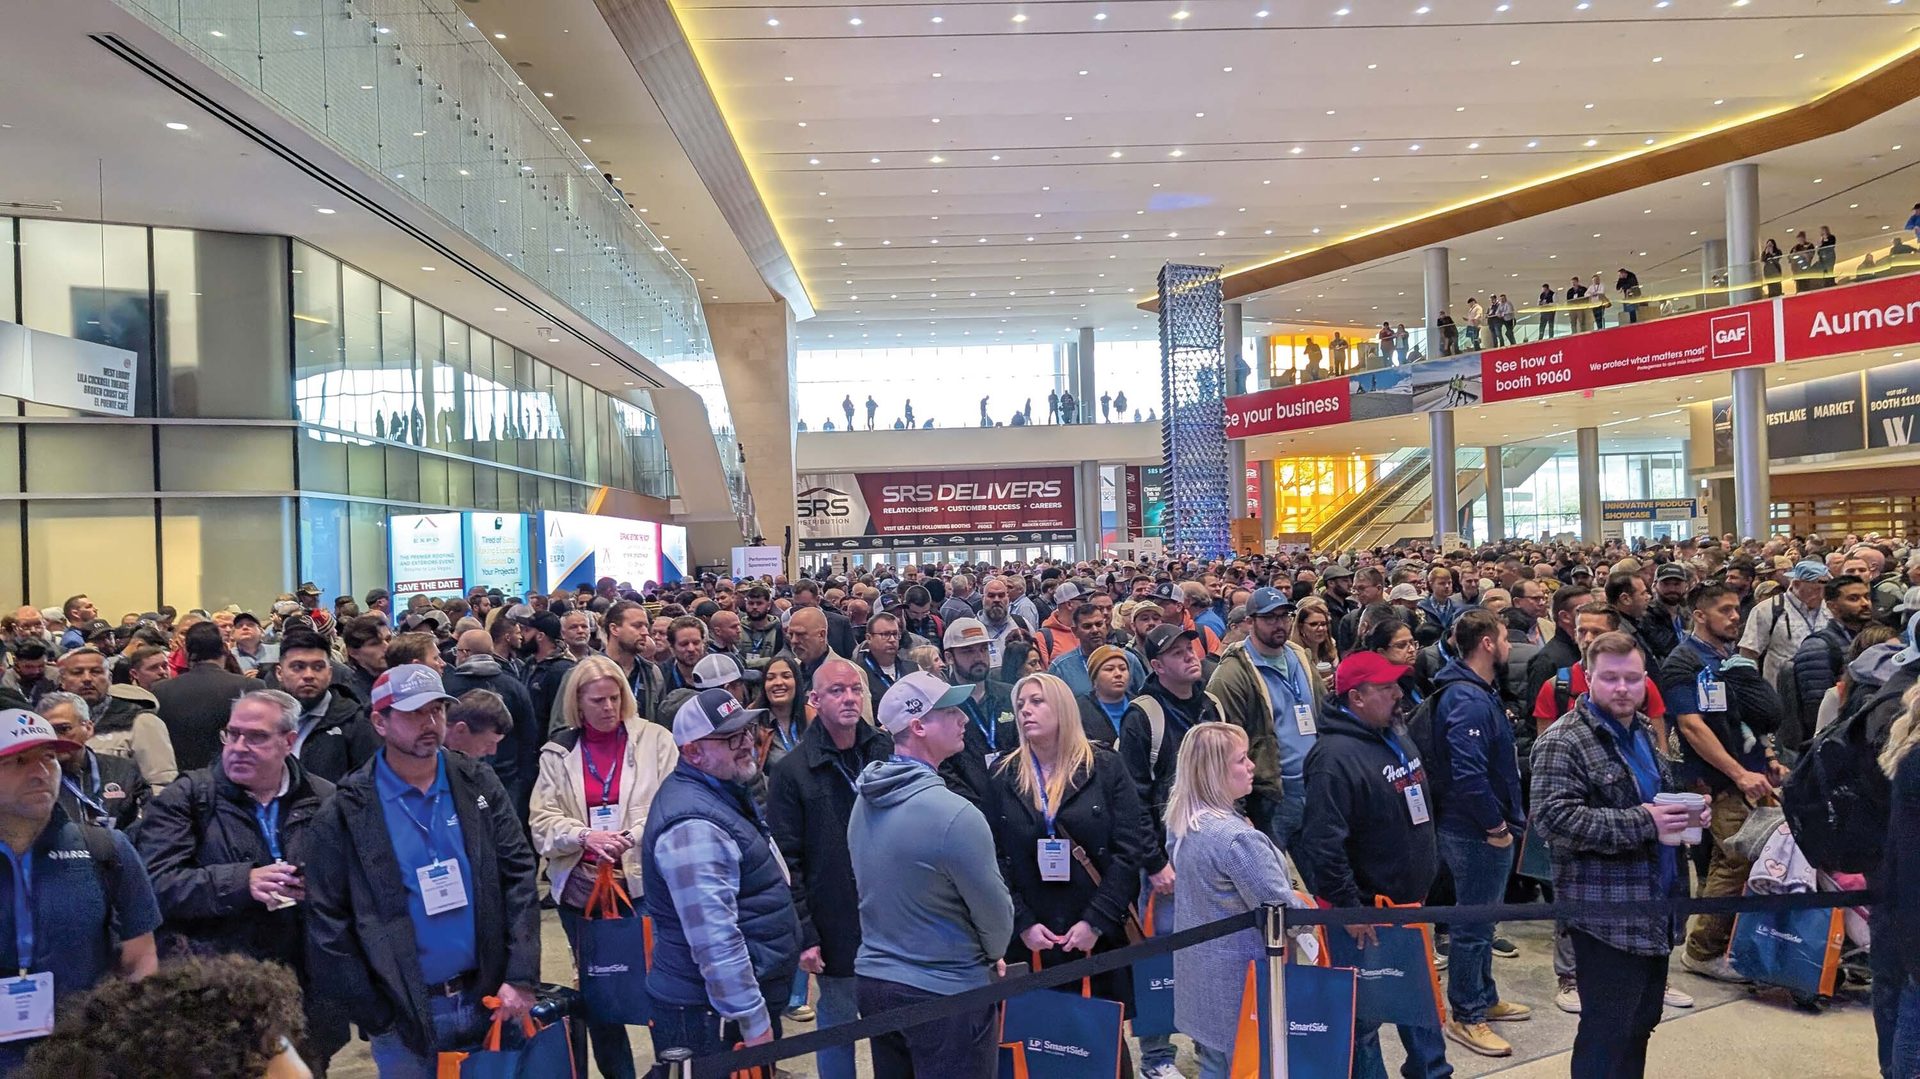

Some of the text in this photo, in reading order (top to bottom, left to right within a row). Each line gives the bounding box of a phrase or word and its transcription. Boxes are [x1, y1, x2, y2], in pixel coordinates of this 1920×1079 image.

[1715, 326, 1747, 344] GAF
[1495, 350, 1563, 373] See how at
[1589, 363, 1601, 372] We
[1602, 357, 1629, 371] protect
[1630, 354, 1650, 365] what
[1651, 349, 1683, 361] matters
[1496, 368, 1571, 392] booth 19060
[1224, 396, 1340, 428] ce your business
[1813, 400, 1856, 419] MARKET
[1870, 397, 1900, 412] BOOTH
[882, 480, 1062, 503] SRS DELIVERS
[797, 498, 850, 517] SRS
[883, 506, 939, 514] RELATIONSHIPS
[1605, 499, 1694, 509] INNOVATIVE PRODUCT
[1604, 511, 1651, 519] SHOWCASE
[481, 535, 496, 544] Tired
[481, 567, 519, 577] Your Projects?
[397, 580, 460, 592] SAVE THE DATE
[1361, 968, 1405, 977] SmartSide
[1289, 1021, 1329, 1033] SmartSide
[1029, 1039, 1042, 1048] LP
[1044, 1040, 1090, 1058] SmartSide
